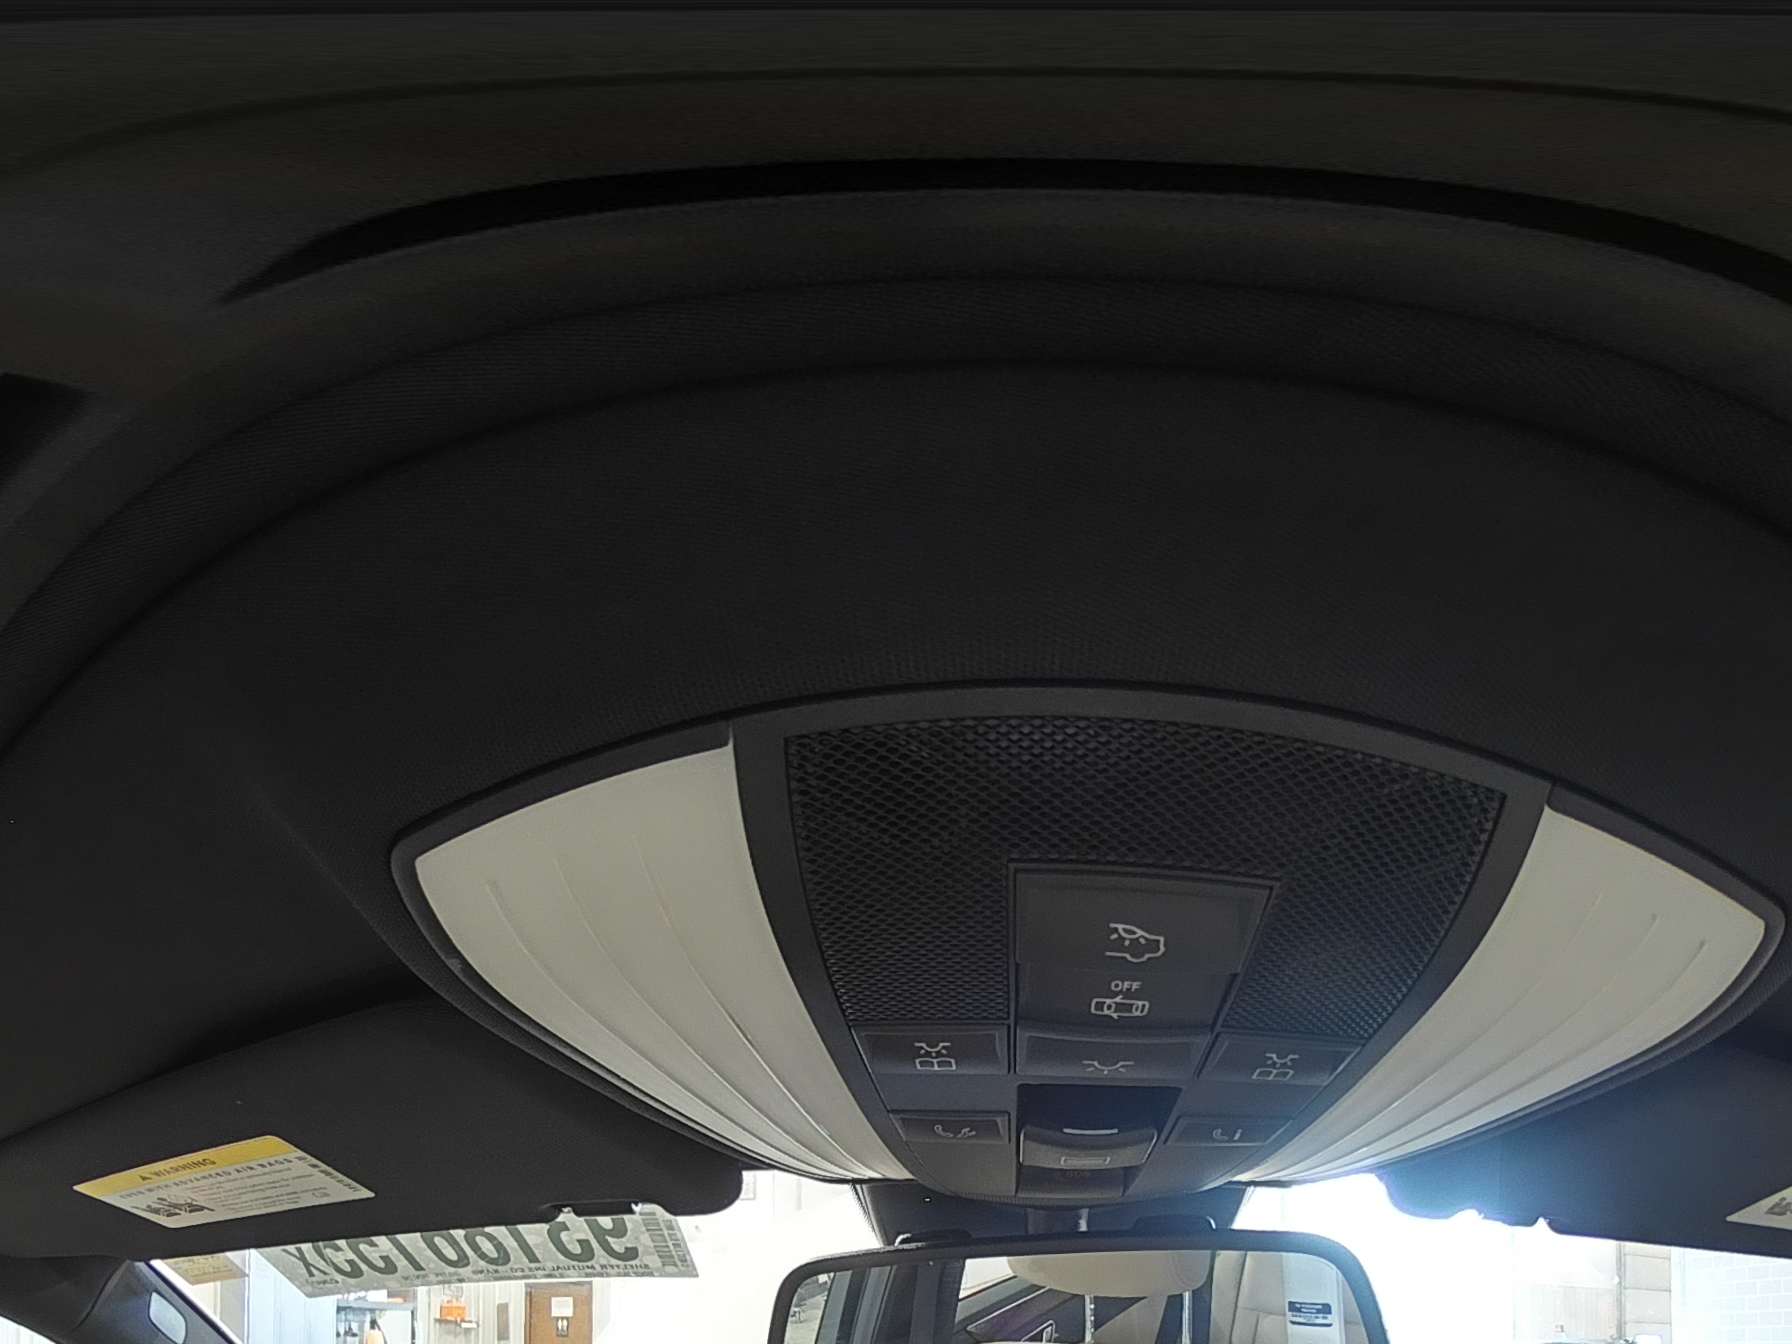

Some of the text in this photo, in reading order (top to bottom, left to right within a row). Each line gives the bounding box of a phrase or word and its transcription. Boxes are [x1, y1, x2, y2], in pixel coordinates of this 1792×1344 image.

[1110, 980, 1142, 993] OFF
[149, 1158, 217, 1177] WARNING
[235, 1165, 256, 1175] AIR
[257, 1157, 293, 1169] BAGS
